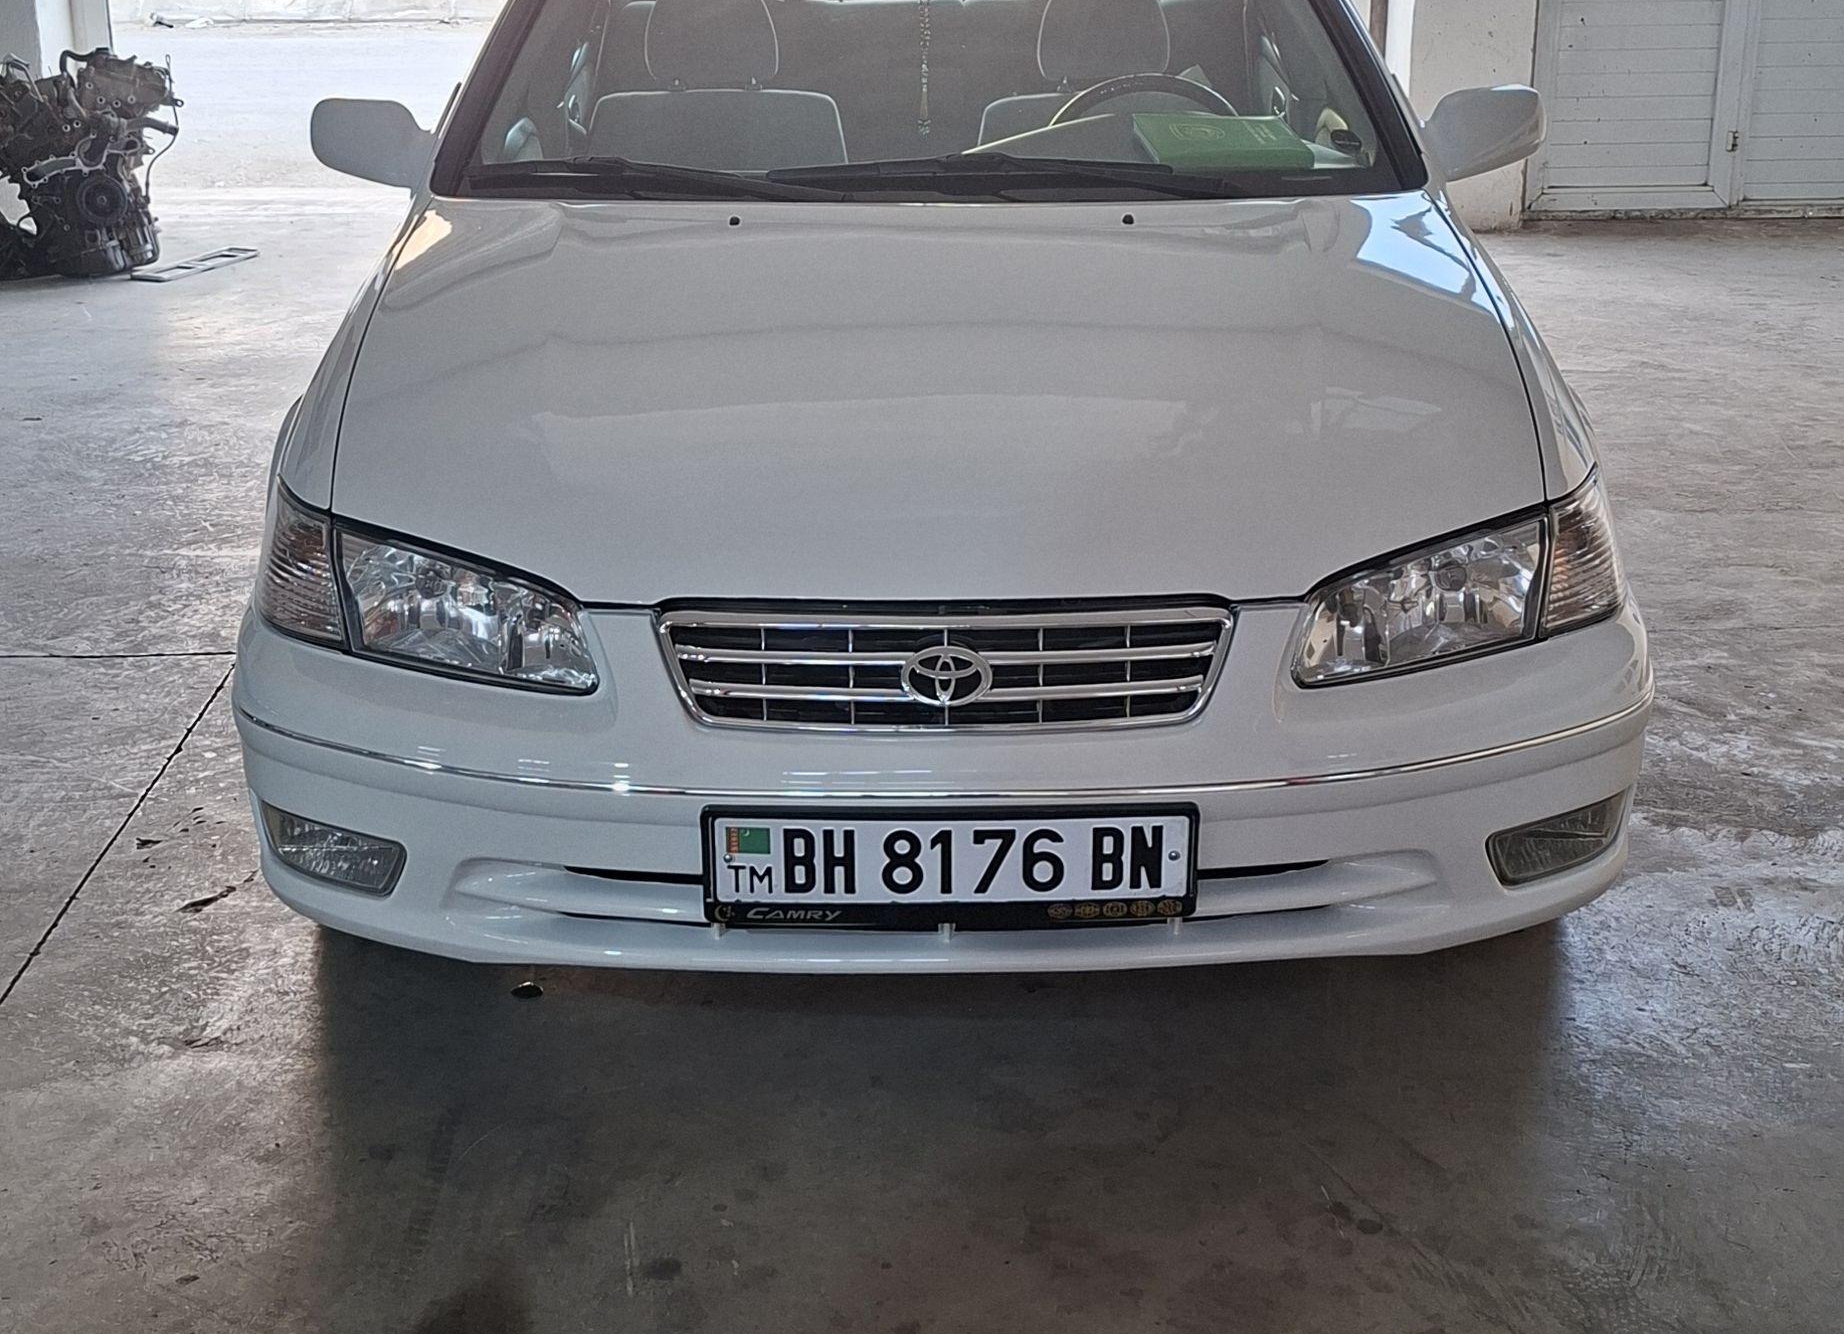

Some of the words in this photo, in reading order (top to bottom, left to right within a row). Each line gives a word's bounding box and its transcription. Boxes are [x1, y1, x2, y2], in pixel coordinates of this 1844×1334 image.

[783, 827, 857, 895] BH
[881, 826, 1065, 895] 8176
[1091, 824, 1164, 891] BN
[726, 864, 774, 894] TM
[745, 907, 843, 922] CAMRY
